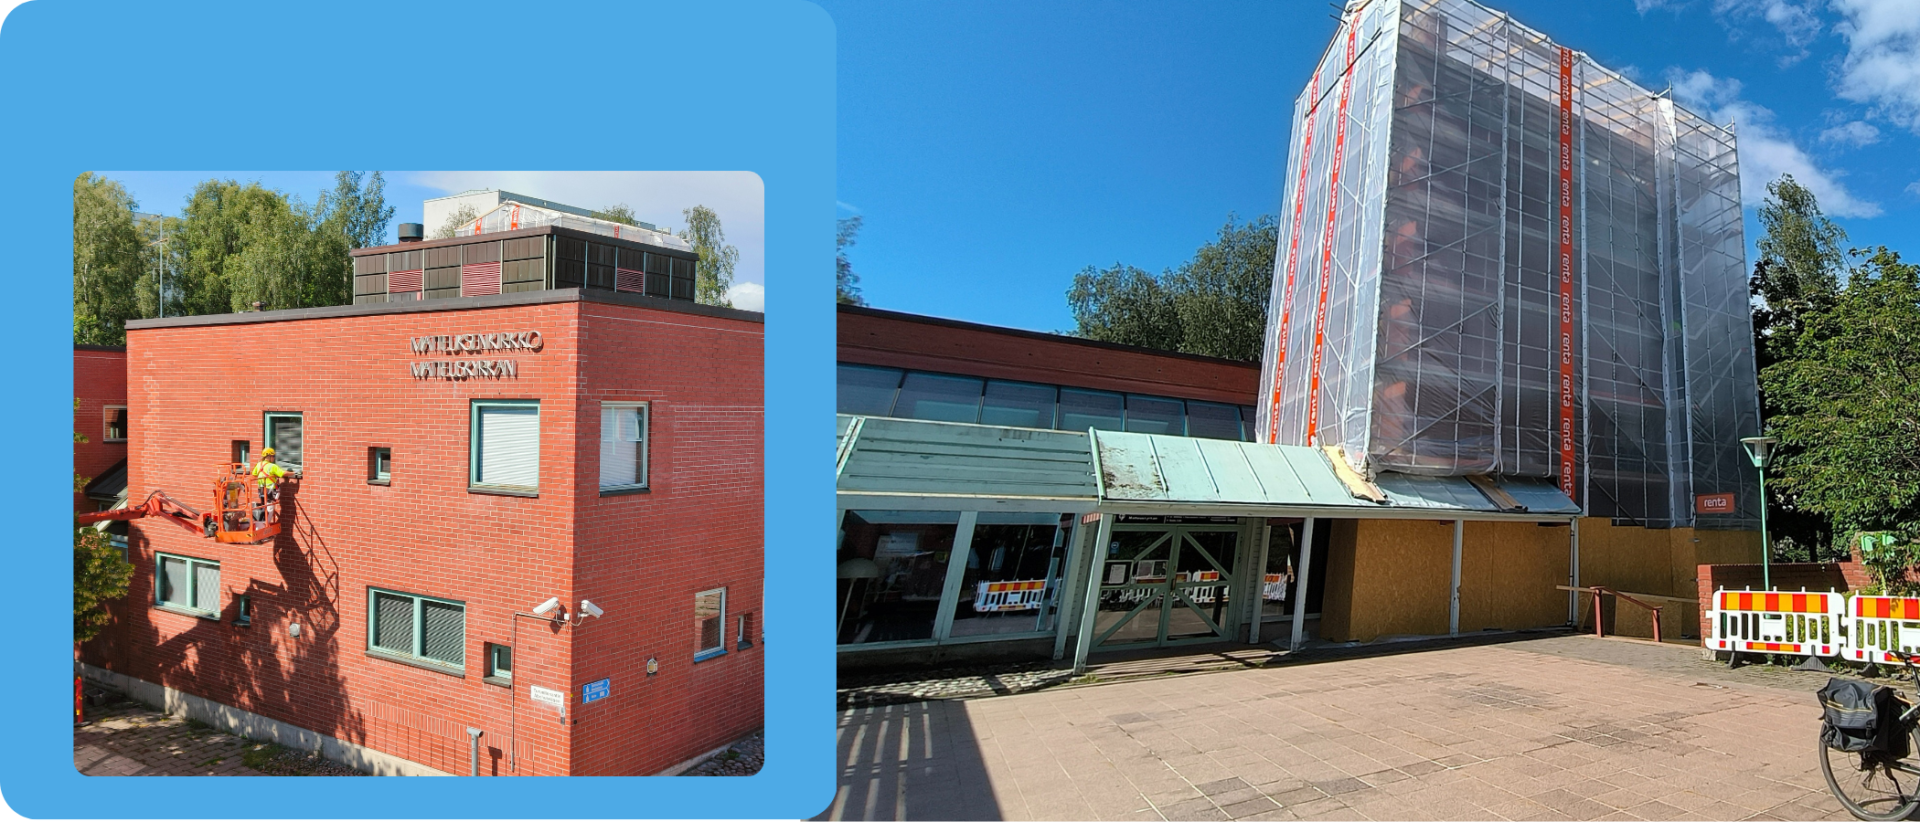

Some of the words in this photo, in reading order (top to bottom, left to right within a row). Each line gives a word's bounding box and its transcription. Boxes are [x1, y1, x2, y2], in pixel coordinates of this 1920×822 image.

[1562, 74, 1570, 101] renta
[1562, 108, 1570, 135] renta
[1562, 142, 1570, 171] renta
[1562, 178, 1570, 207] renta
[1562, 215, 1571, 245] renta
[1562, 253, 1571, 283] renta
[1562, 292, 1571, 323] renta
[1563, 332, 1571, 364] renta
[1563, 374, 1571, 407] renta
[1563, 417, 1572, 451] renta
[1704, 498, 1727, 507] renta
